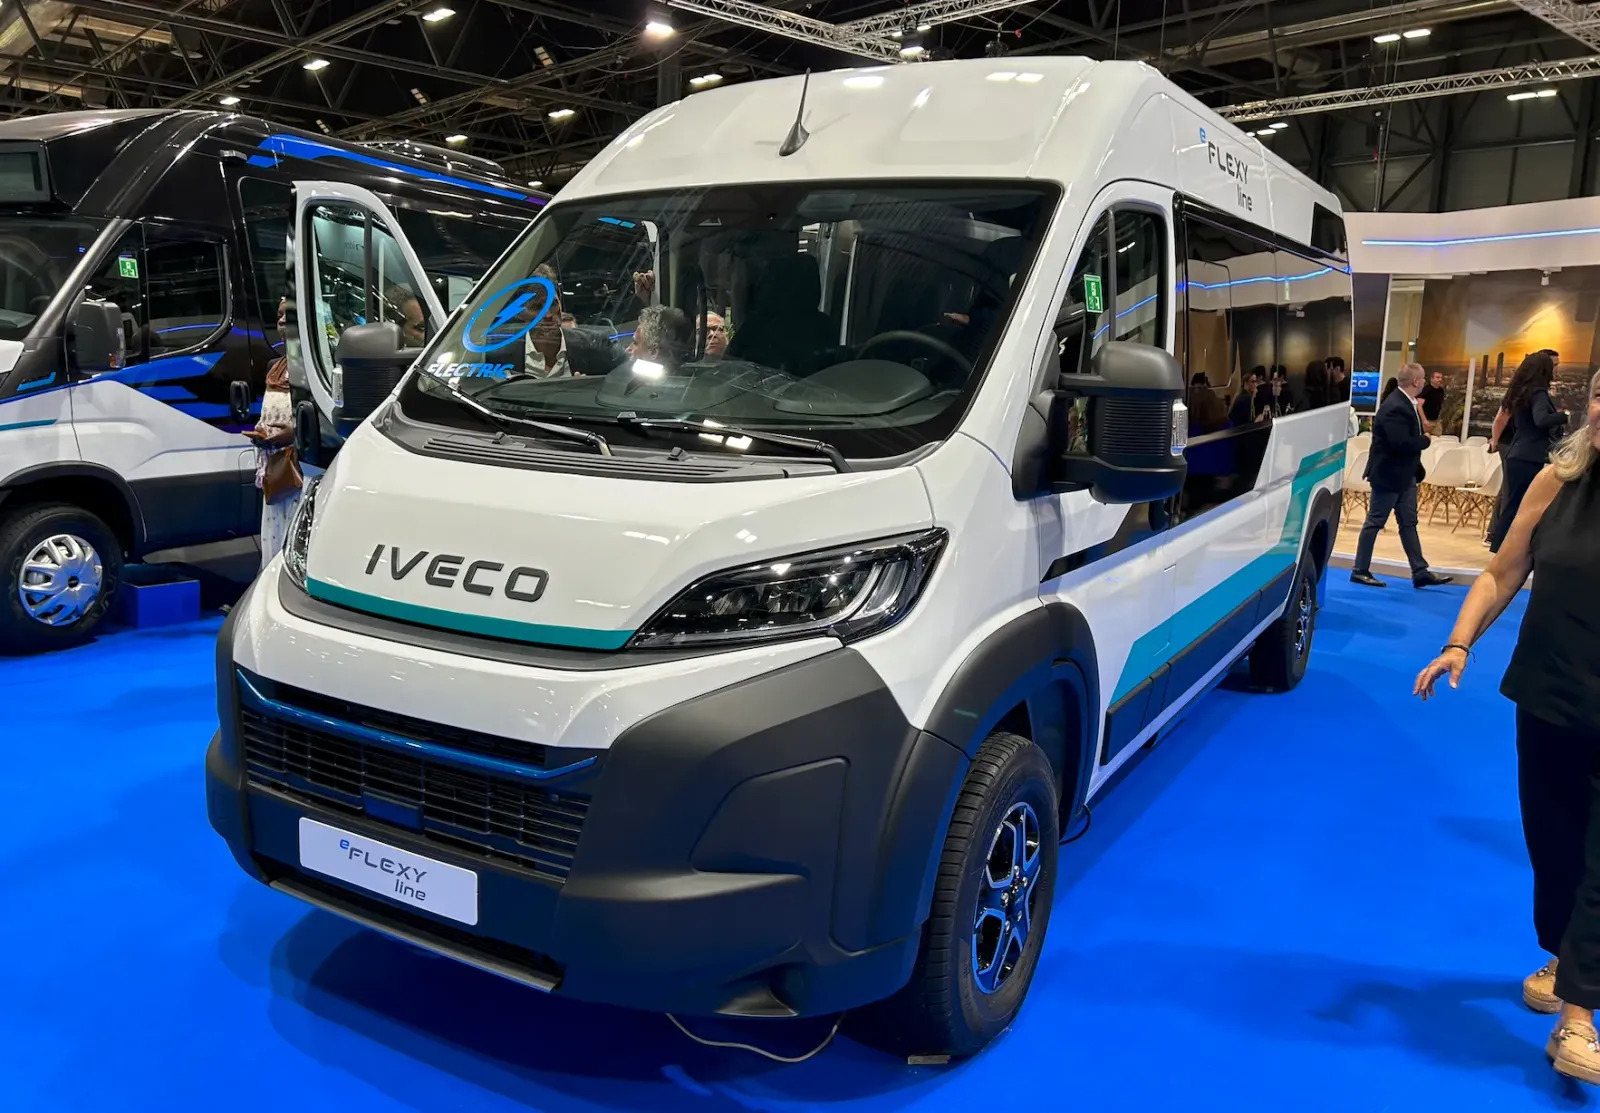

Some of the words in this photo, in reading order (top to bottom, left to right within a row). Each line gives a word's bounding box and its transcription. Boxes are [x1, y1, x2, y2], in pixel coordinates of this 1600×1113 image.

[1236, 184, 1253, 212] line
[427, 362, 515, 379] ELECTRIC
[365, 543, 549, 603] IVECO
[394, 878, 426, 901] line
